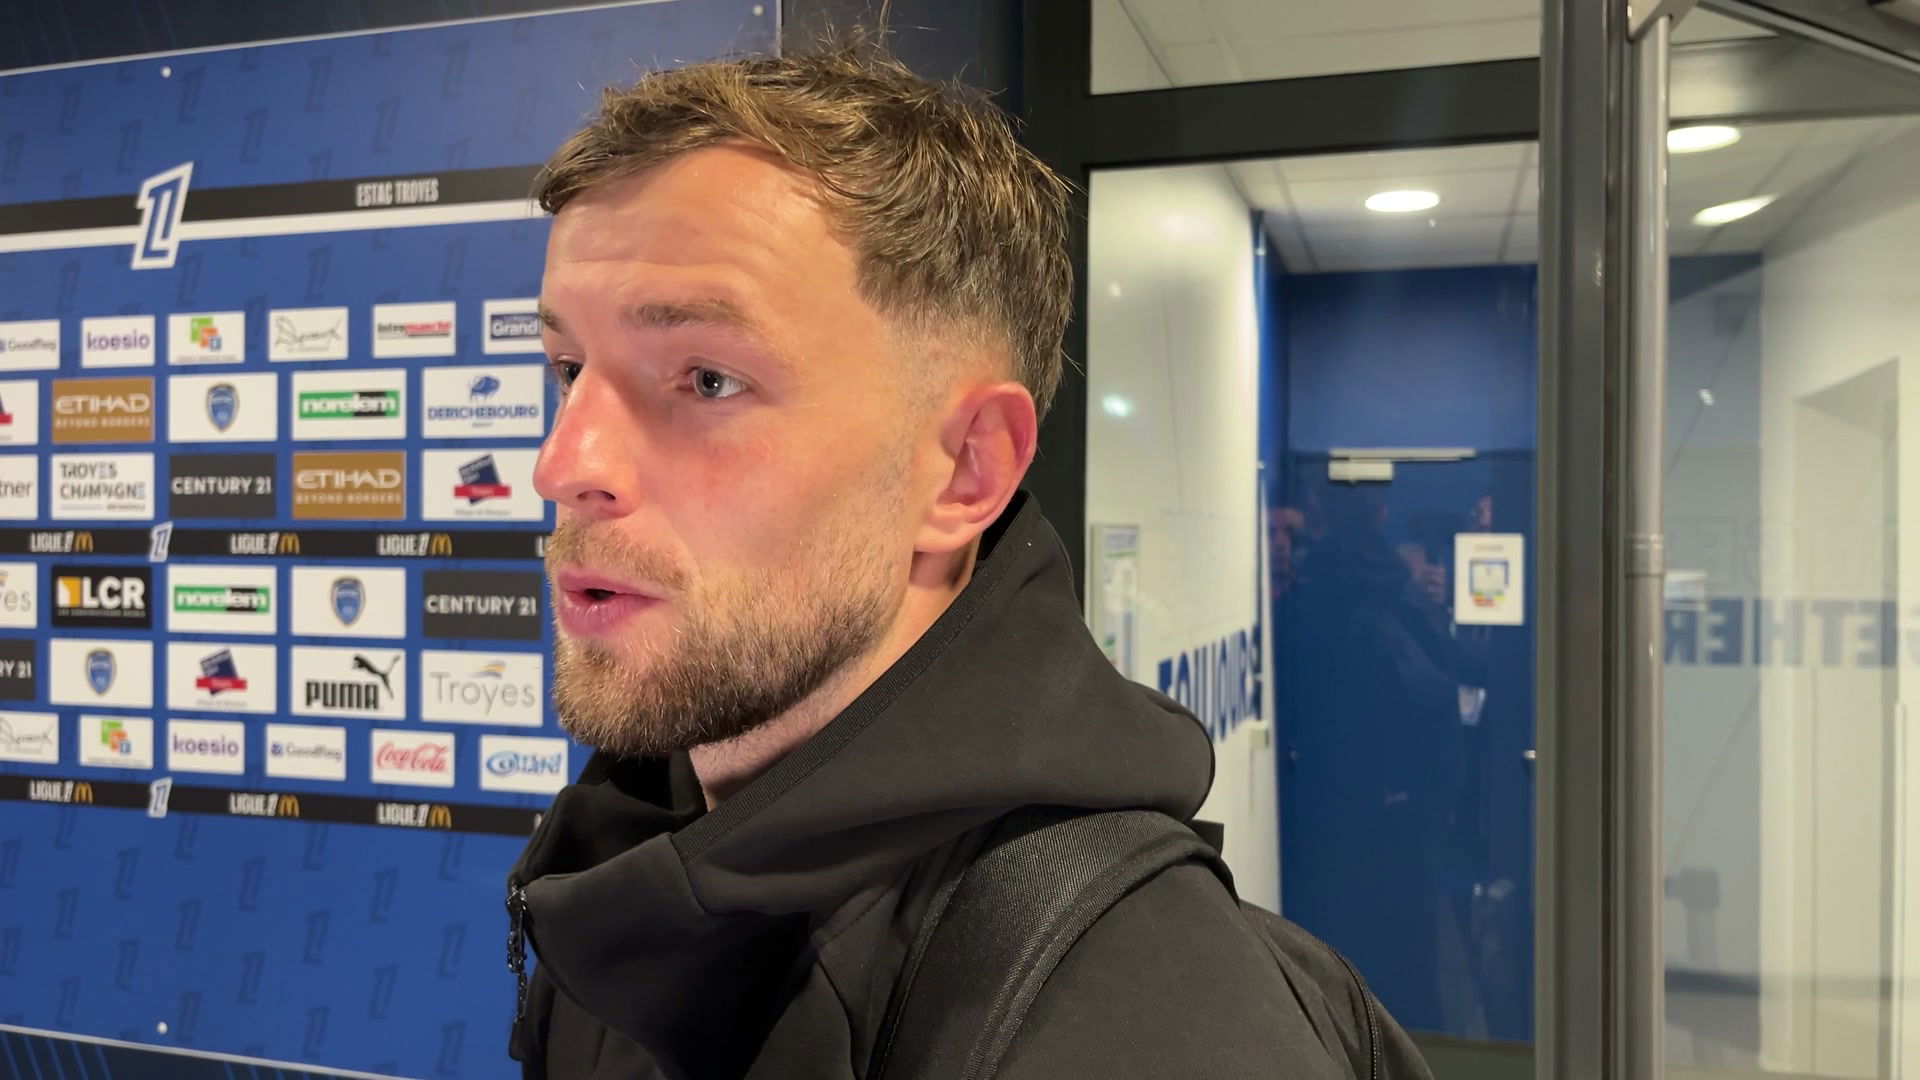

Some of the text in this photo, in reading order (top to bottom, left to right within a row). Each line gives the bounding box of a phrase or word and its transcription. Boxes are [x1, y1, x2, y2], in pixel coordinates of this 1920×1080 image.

[356, 178, 439, 207] ESTAC TROYES
[492, 318, 539, 337] Grand
[86, 329, 150, 350] koesio
[55, 393, 150, 414] ETIHAD
[303, 393, 396, 413] norelem
[427, 405, 539, 421] DERICHEBOURG
[60, 462, 117, 479] TROYES
[296, 468, 401, 489] ETIHAD
[172, 476, 272, 495] CENTURY 21
[82, 576, 146, 609] LCR
[177, 588, 267, 607] norelem
[425, 595, 536, 616] CENTURY 21
[306, 681, 379, 710] PUMA
[430, 671, 536, 715] Troyes
[173, 732, 239, 757] koesio
